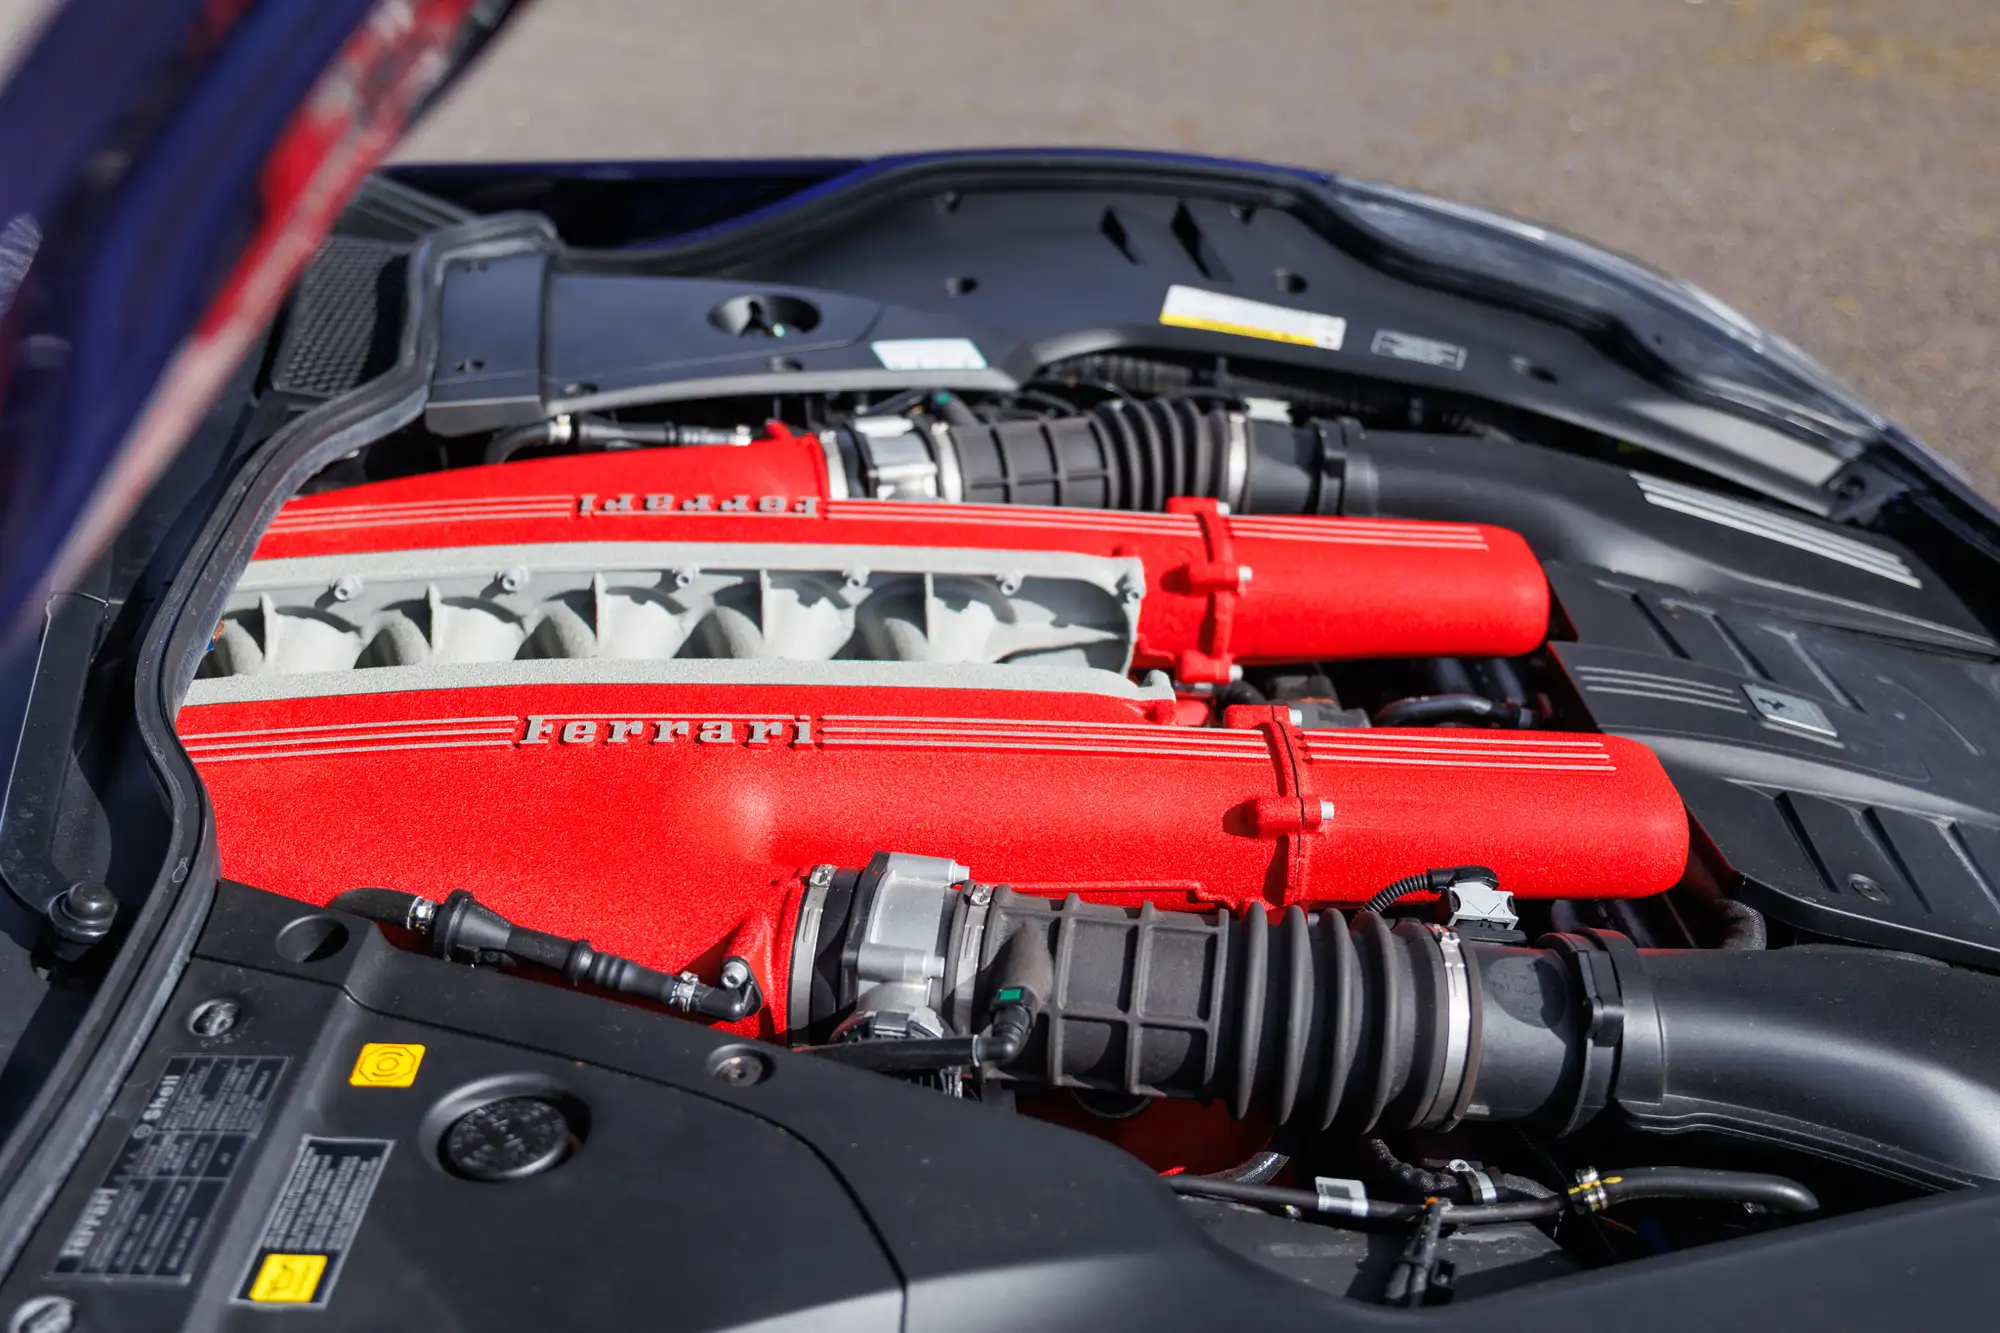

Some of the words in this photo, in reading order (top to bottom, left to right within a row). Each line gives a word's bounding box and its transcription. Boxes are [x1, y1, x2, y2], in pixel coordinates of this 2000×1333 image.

[579, 494, 820, 518] Ferrari
[519, 714, 814, 744] Ferrari
[143, 1075, 181, 1120] Shell
[59, 1189, 119, 1257] Ferrari
